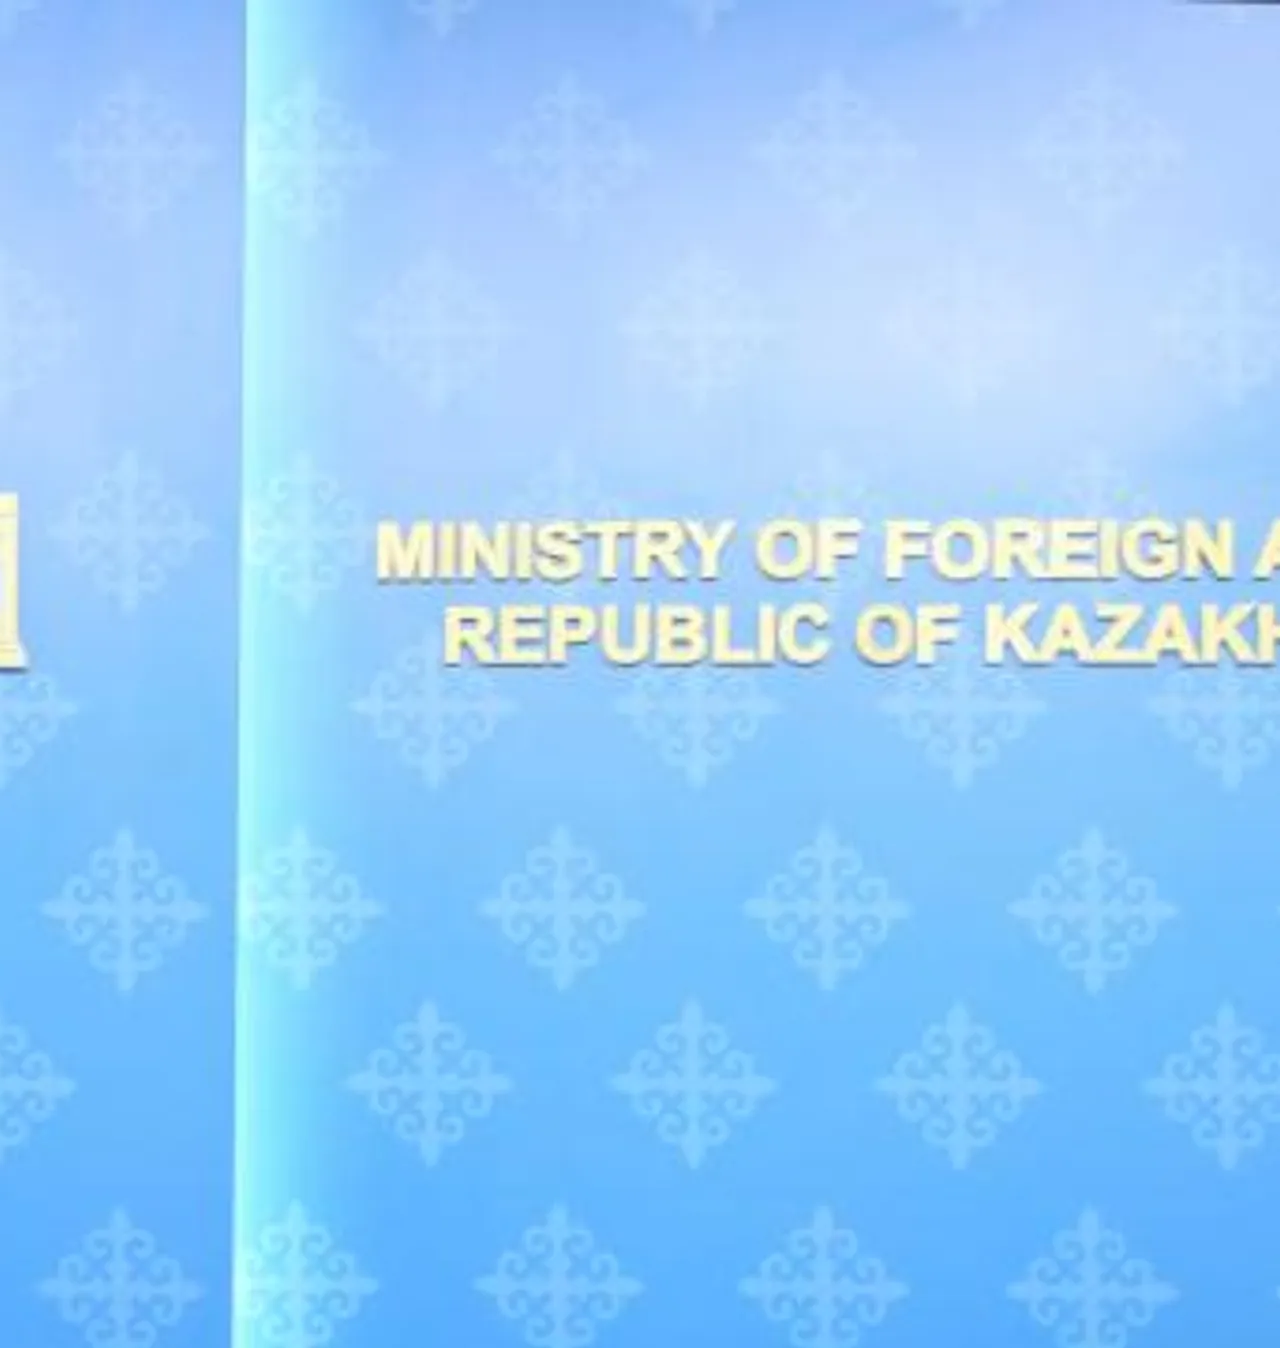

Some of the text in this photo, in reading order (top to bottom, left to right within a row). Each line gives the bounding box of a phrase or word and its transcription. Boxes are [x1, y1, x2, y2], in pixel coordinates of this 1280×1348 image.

[374, 517, 736, 579] MINISTRY
[752, 516, 864, 579] OF
[883, 516, 1235, 580] FOREIGN
[443, 601, 829, 665] REPUBLIC
[854, 602, 961, 665] OF
